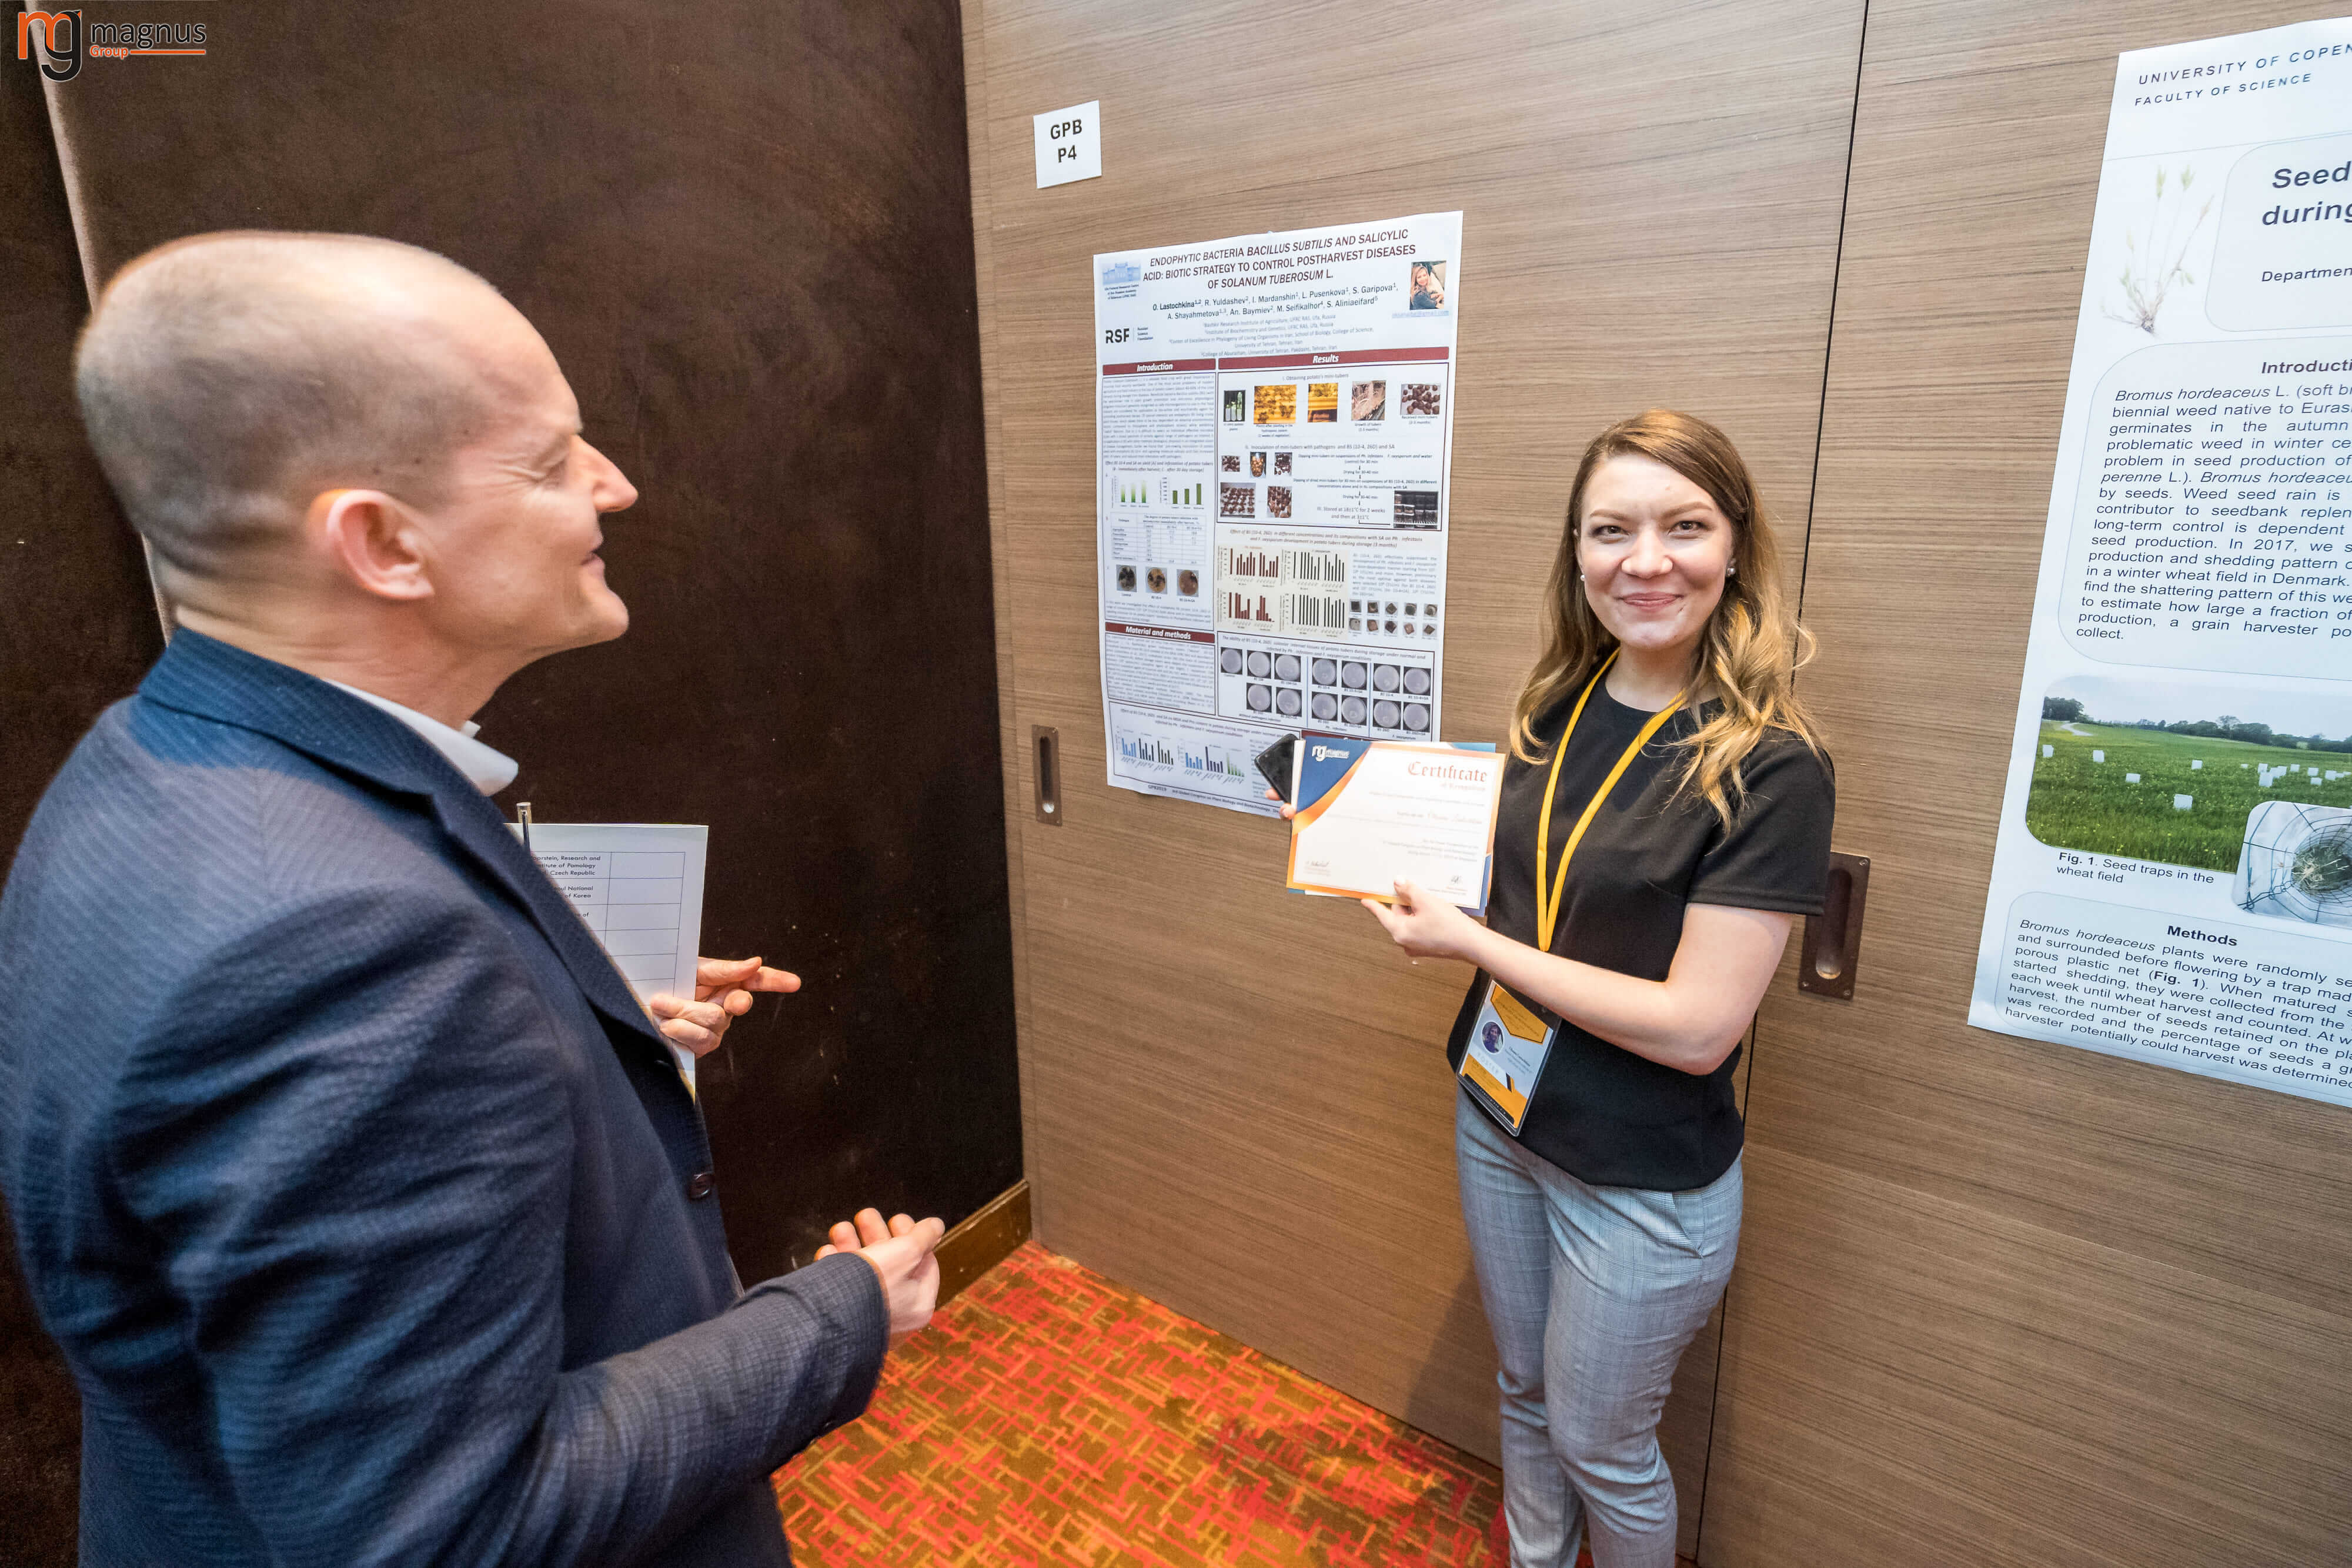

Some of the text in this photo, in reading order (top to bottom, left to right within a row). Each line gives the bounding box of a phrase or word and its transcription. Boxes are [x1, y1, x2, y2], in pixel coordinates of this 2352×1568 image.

[2139, 61, 2246, 85] UNIVERSITY
[2256, 56, 2279, 68] OF
[2136, 73, 2311, 106] FACULTY OF SCIENCE
[1050, 119, 1082, 139] GPB
[1058, 145, 1077, 163] P4
[2272, 161, 2351, 188] Seed
[1150, 229, 1408, 266] ENDOPHYTIC BACTERIA BACILLUS SUBTILIS AND SALICYLIC
[1143, 245, 1415, 281] ACID: BIOTIC STRATEGY TO CONTROL POSTHARVEST DISEASES
[1208, 269, 1333, 289] OF SOLANUM TUBEROSUM L.
[1105, 328, 1130, 343] RSF
[1312, 354, 1339, 363] Results
[1137, 362, 1173, 372] Introduction
[2115, 385, 2333, 401] Bromus hordeaceus L. (soft
[2113, 406, 2169, 417] biennial
[2176, 404, 2217, 416] weed
[2224, 404, 2271, 415] native
[2280, 404, 2293, 414] to
[2110, 421, 2348, 436] germinates in the autumn
[2107, 438, 2324, 452] problematic weed in winter
[2104, 456, 2163, 468] problem
[2173, 456, 2184, 466] in
[2194, 455, 2231, 466] seed
[2240, 455, 2325, 468] production
[2101, 474, 2161, 484] perenne
[2169, 472, 2191, 484] L.).
[2200, 472, 2261, 482] Bromus
[2099, 488, 2340, 500] by seeds. Weed seed rain is
[2097, 504, 2174, 514] contributor
[2186, 506, 2199, 515] to
[2211, 506, 2288, 516] seedbank
[2094, 519, 2345, 536] long-term control is dependent
[2092, 536, 2333, 552] seed production. In 2017, we
[1126, 626, 1151, 635] Material
[1165, 630, 1191, 639] methods
[1408, 762, 1488, 782] Certificate
[2057, 867, 2123, 882] wheat field
[2059, 852, 2214, 883] Fig. 1. Seed traps in the
[2167, 925, 2237, 945] Methods
[2020, 920, 2327, 984] Bromus hordeaceus plants were randomly
